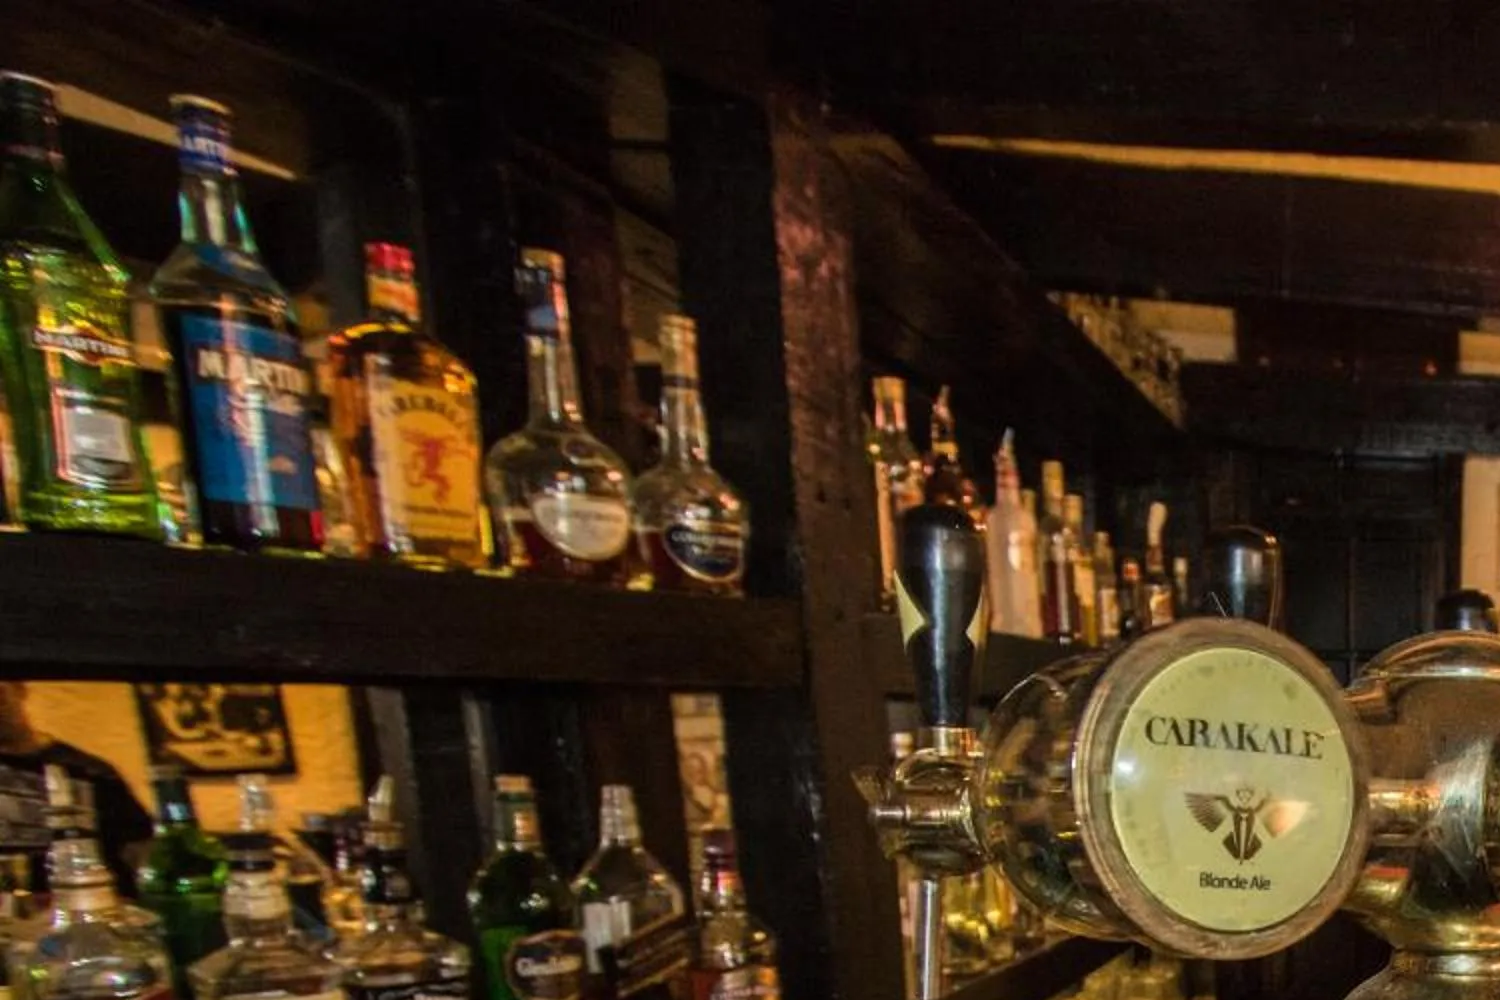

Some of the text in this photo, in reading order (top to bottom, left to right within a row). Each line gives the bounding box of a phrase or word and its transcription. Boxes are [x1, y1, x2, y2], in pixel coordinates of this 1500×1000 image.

[1145, 716, 1325, 760] CARAKALE
[1199, 872, 1272, 891] Blonde Ale
